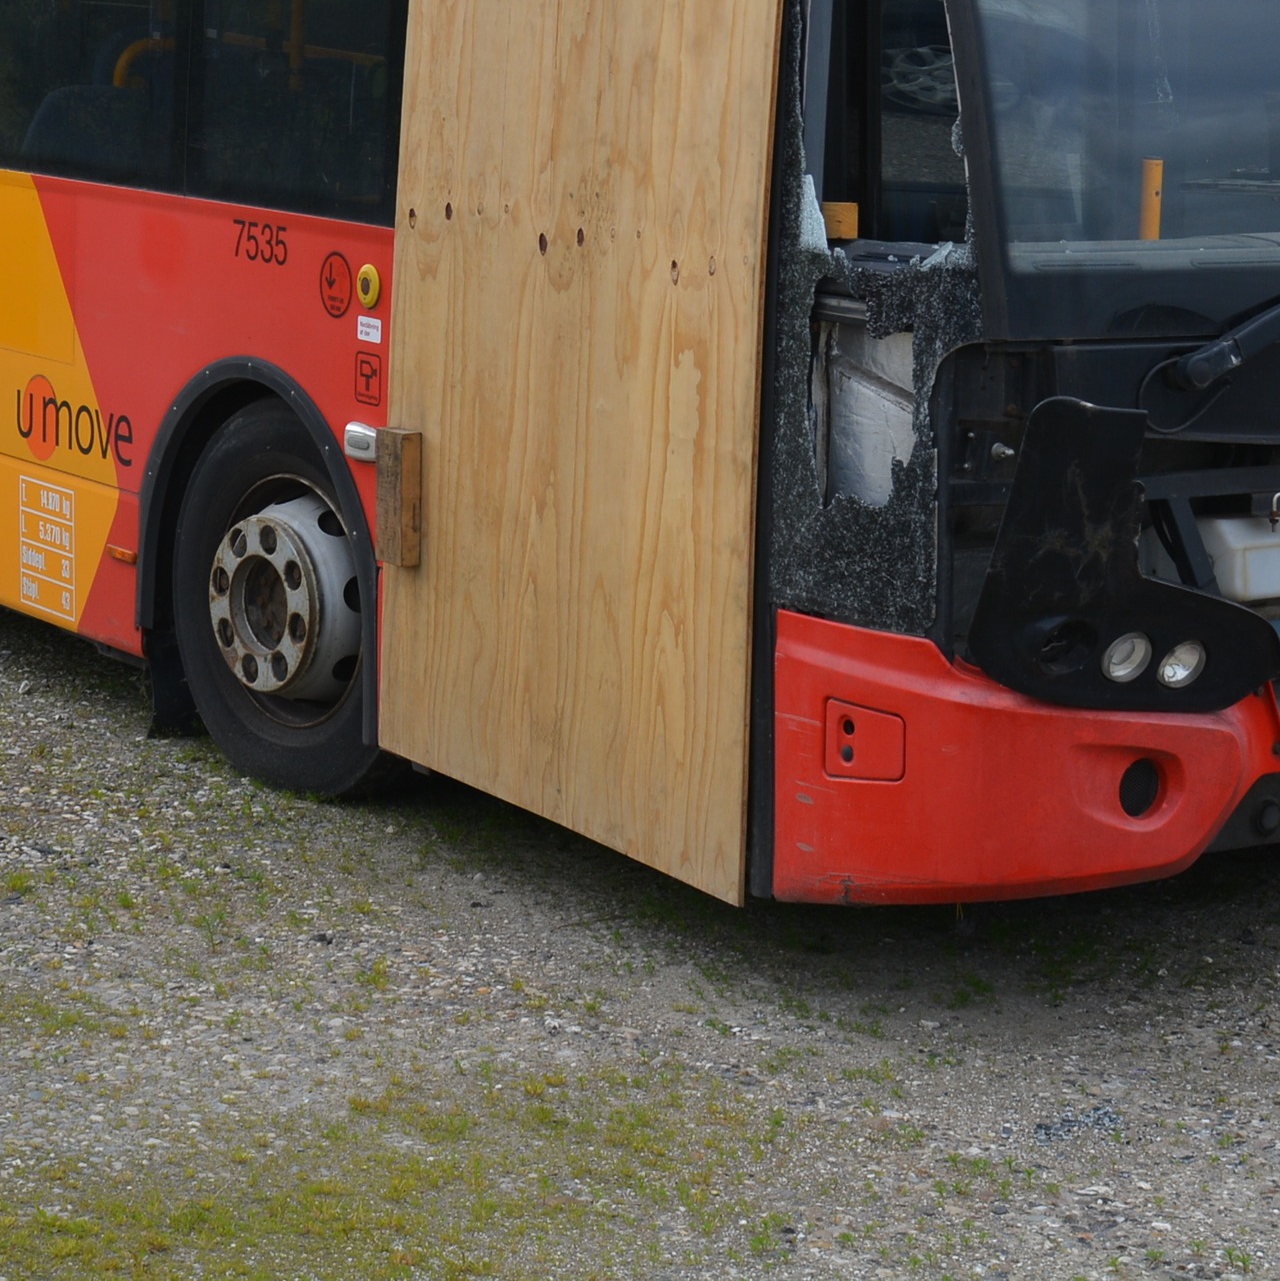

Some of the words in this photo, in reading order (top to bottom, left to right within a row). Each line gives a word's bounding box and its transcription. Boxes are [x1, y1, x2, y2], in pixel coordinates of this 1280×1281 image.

[232, 218, 288, 266] 7535
[62, 496, 70, 519] kg
[39, 521, 61, 545] 5.370
[61, 527, 70, 551] kg
